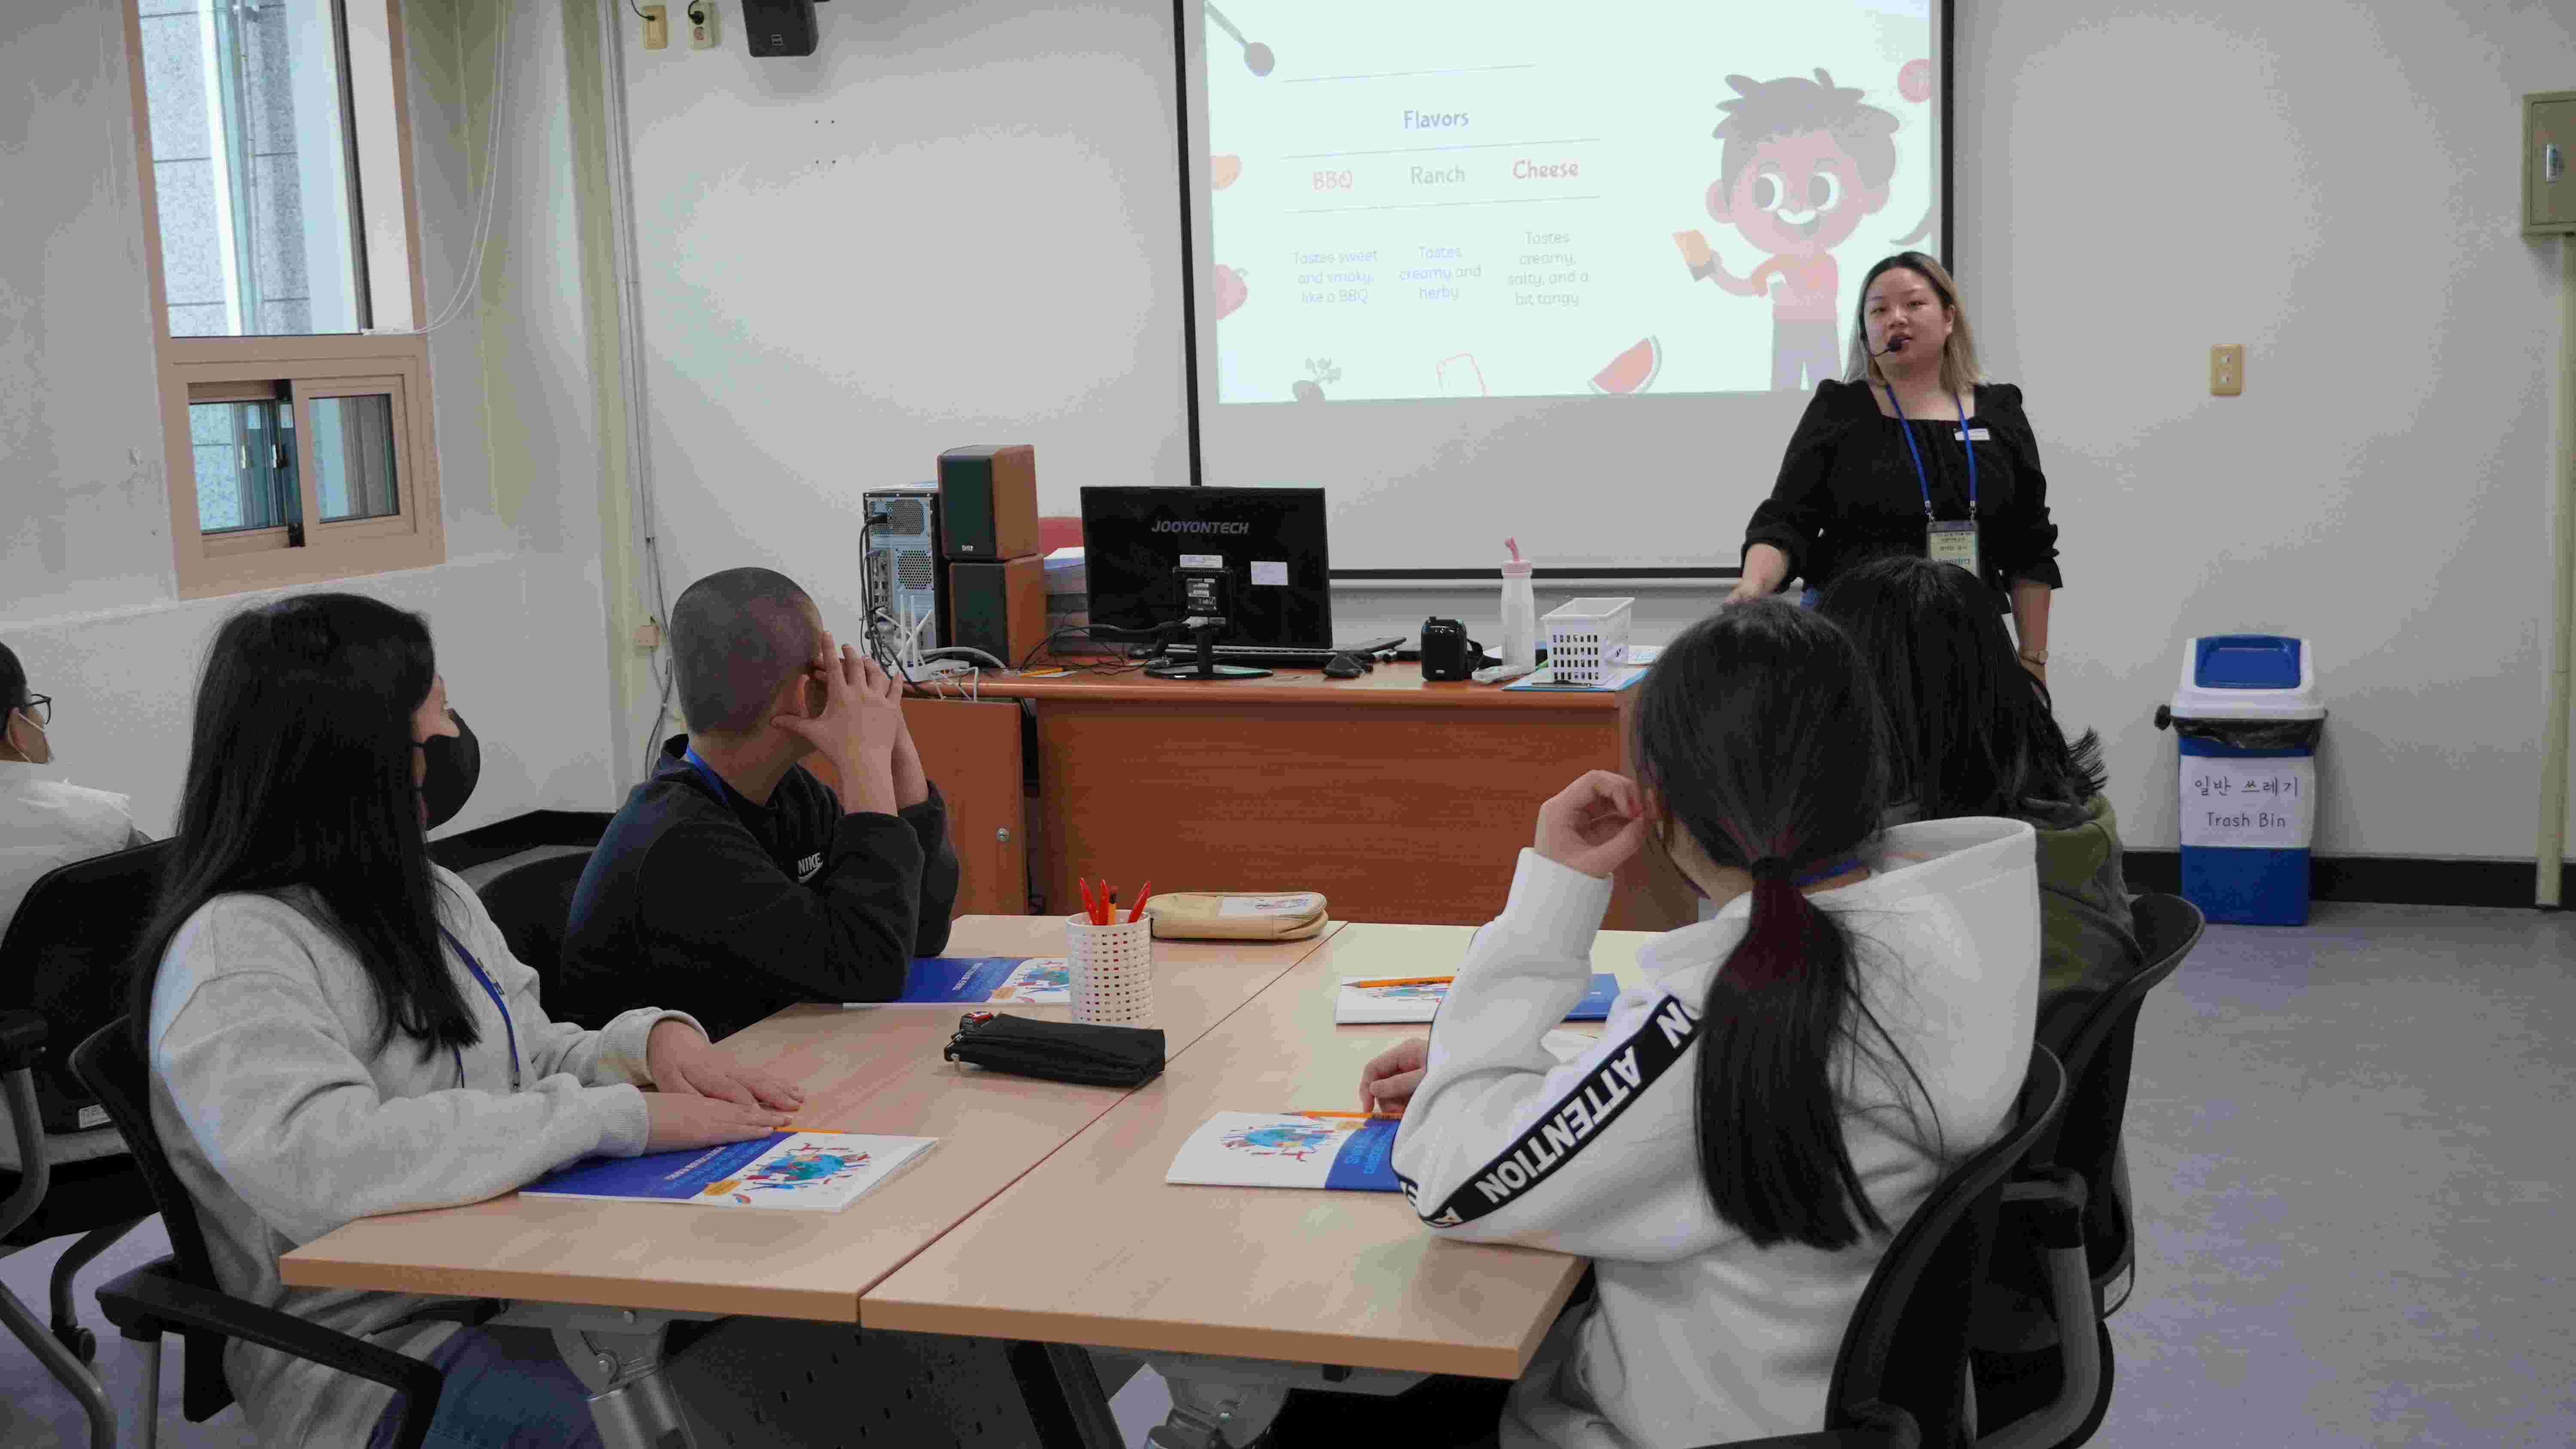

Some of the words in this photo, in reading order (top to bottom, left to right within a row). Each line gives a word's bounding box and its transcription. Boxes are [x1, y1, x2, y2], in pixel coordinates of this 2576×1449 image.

[1403, 110, 1469, 129] Flavors
[1410, 165, 1465, 185] Ranch
[1513, 158, 1579, 179] Cheese
[1312, 170, 1353, 190] BBQ
[1525, 230, 1570, 244] Tastes
[1292, 250, 1335, 264] Tastes
[1338, 249, 1378, 263] sweet
[1419, 244, 1463, 258] Tastes
[1519, 253, 1577, 268] creamy,
[1298, 270, 1323, 285] and
[1399, 268, 1451, 282] creamy
[1455, 264, 1481, 279] and
[1507, 270, 1546, 288] salty,
[1548, 268, 1576, 283] and
[1580, 271, 1589, 282] a
[1302, 290, 1323, 304] like
[1327, 292, 1336, 303] a
[1339, 288, 1370, 304] BBQ
[1419, 285, 1459, 302] herby
[1515, 291, 1535, 306] bit
[1537, 293, 1580, 309] tangy
[1151, 521, 1250, 535] JOOYONTECH
[2195, 776, 2232, 796] 일반
[2241, 776, 2298, 797] 쓰레기
[2207, 811, 2251, 828] Trash
[2259, 812, 2286, 828] Bin
[797, 852, 821, 874] NIKE
[1474, 1045, 1643, 1204] ATTENTION
